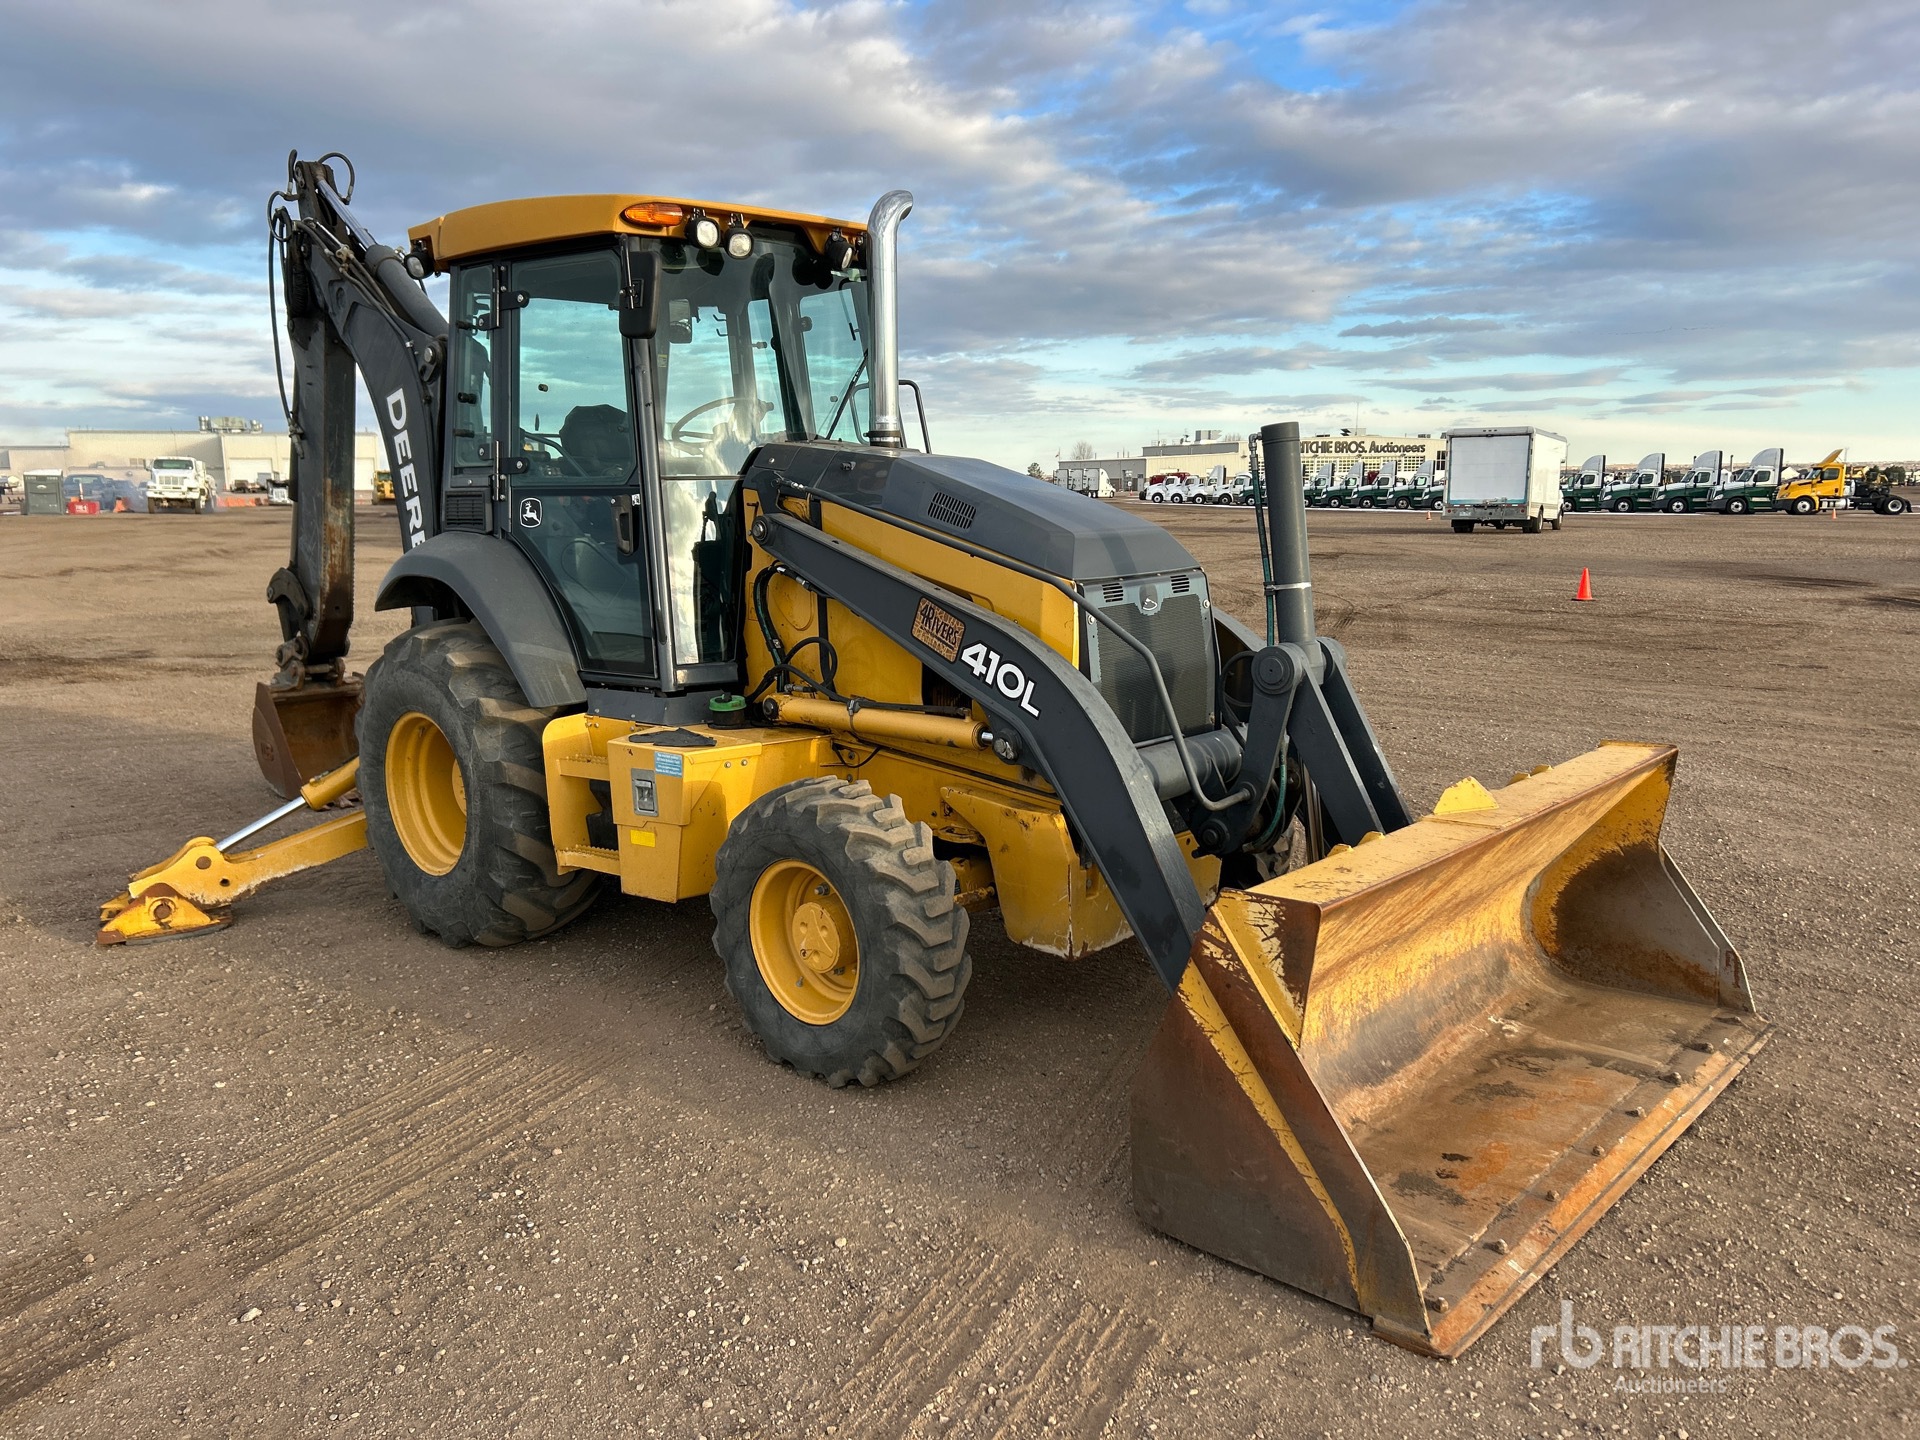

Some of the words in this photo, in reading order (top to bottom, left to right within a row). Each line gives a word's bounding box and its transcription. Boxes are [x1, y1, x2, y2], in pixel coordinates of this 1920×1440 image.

[1335, 441, 1368, 454] BROS.
[1369, 441, 1426, 454] Auctioneers
[961, 643, 1040, 717] 410L
